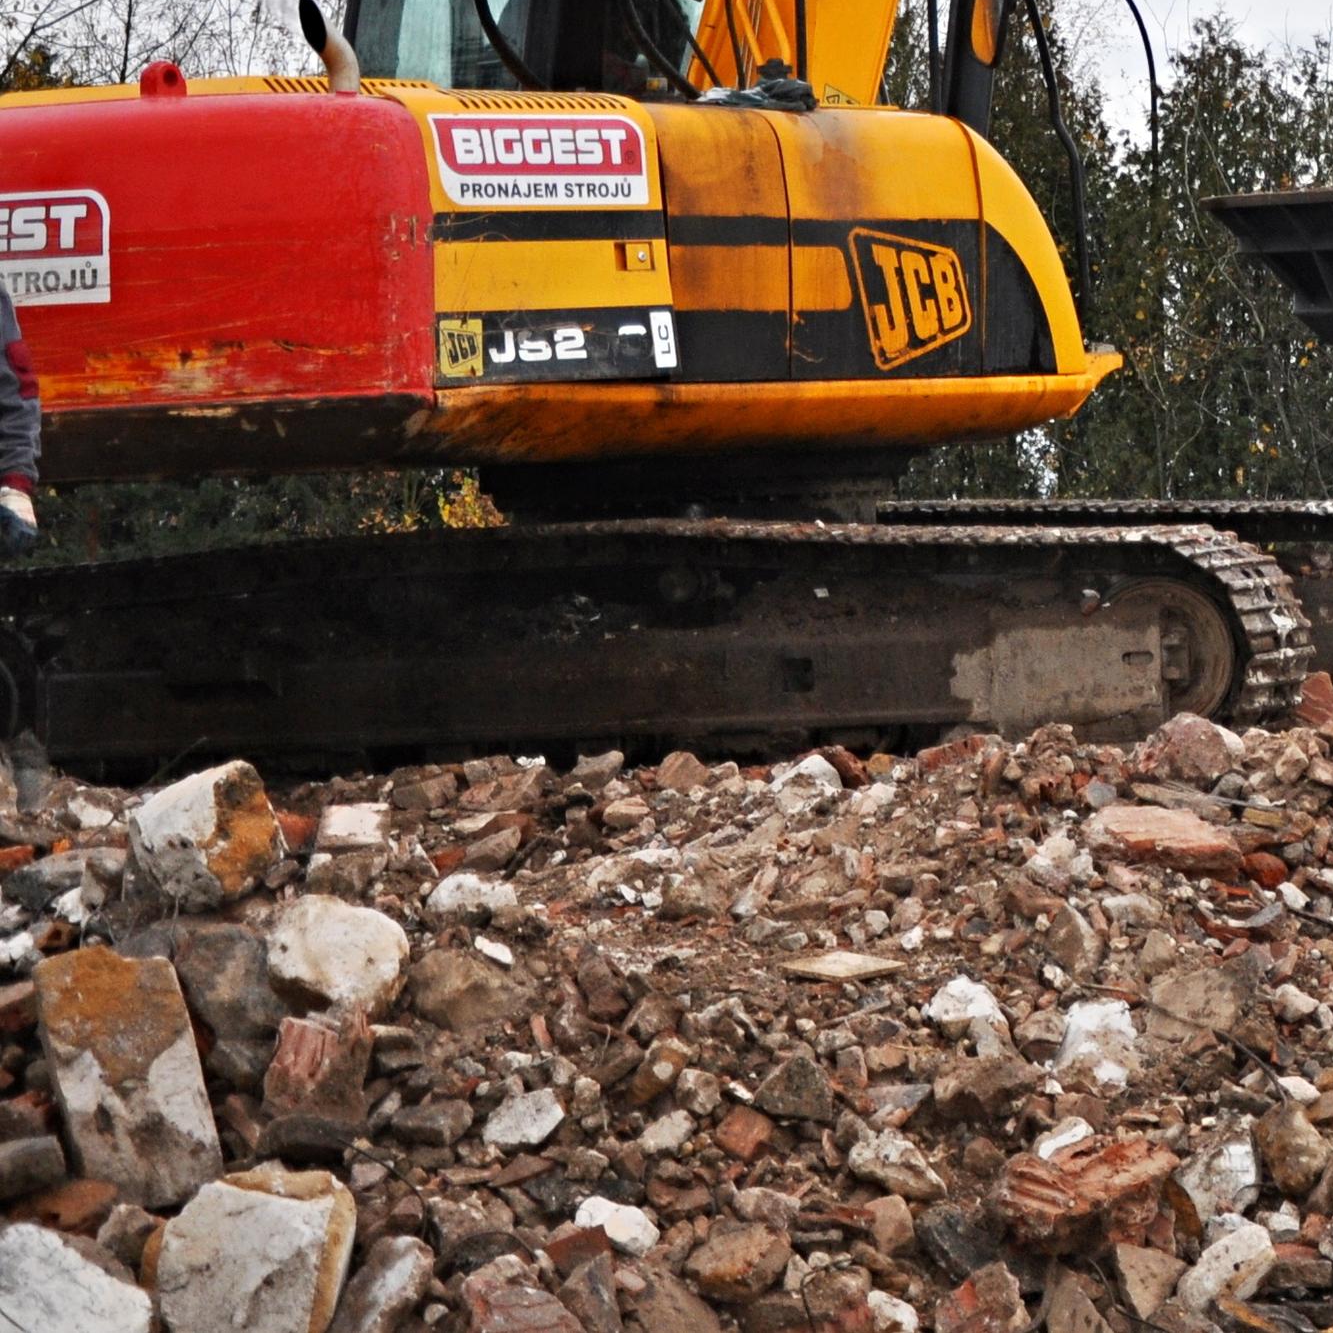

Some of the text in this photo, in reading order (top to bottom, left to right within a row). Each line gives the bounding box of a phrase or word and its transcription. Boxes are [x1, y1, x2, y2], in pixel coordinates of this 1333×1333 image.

[451, 128, 627, 165] BIGGEST
[460, 178, 632, 199] PRONÁJEM STROJŮ
[0, 261, 97, 294] TROJŮ
[872, 244, 963, 358] JCB
[448, 332, 478, 365] JCB
[658, 324, 672, 355] LC
